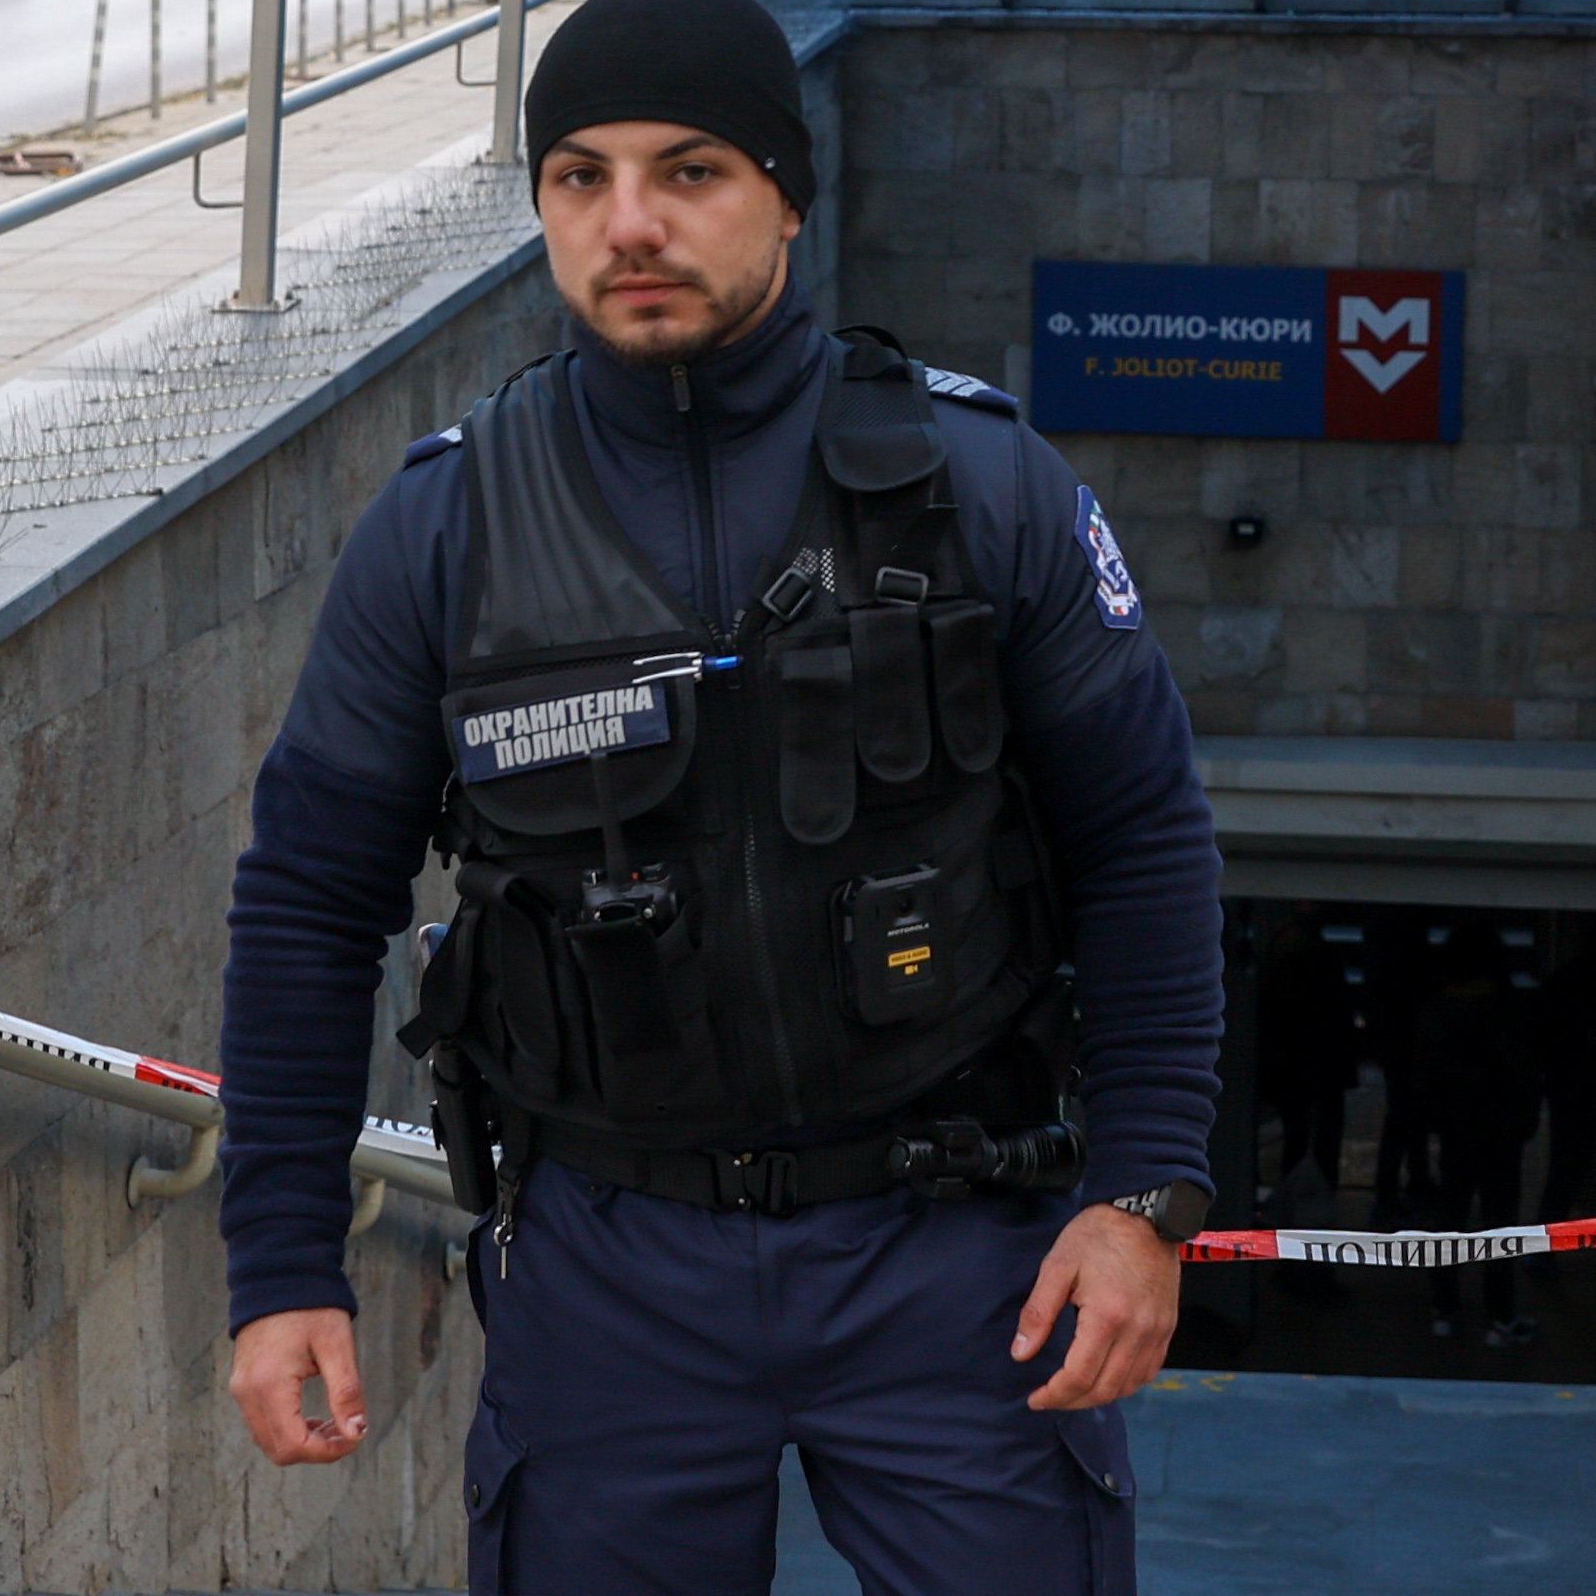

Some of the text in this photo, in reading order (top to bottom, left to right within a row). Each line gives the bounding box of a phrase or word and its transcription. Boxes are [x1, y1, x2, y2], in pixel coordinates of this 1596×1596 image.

[1047, 312, 1313, 344] Ф. ЖОЛИО-КЮРИ
[1085, 358, 1283, 381] F. JOLIOT-CURIE
[463, 684, 654, 748] ОХРАНИТЕЛНА
[494, 715, 627, 770] ПОЛИЦИЯ
[886, 922, 930, 938] MOTOROLA
[1300, 1235, 1527, 1268] ПОЛИЦИЯ
